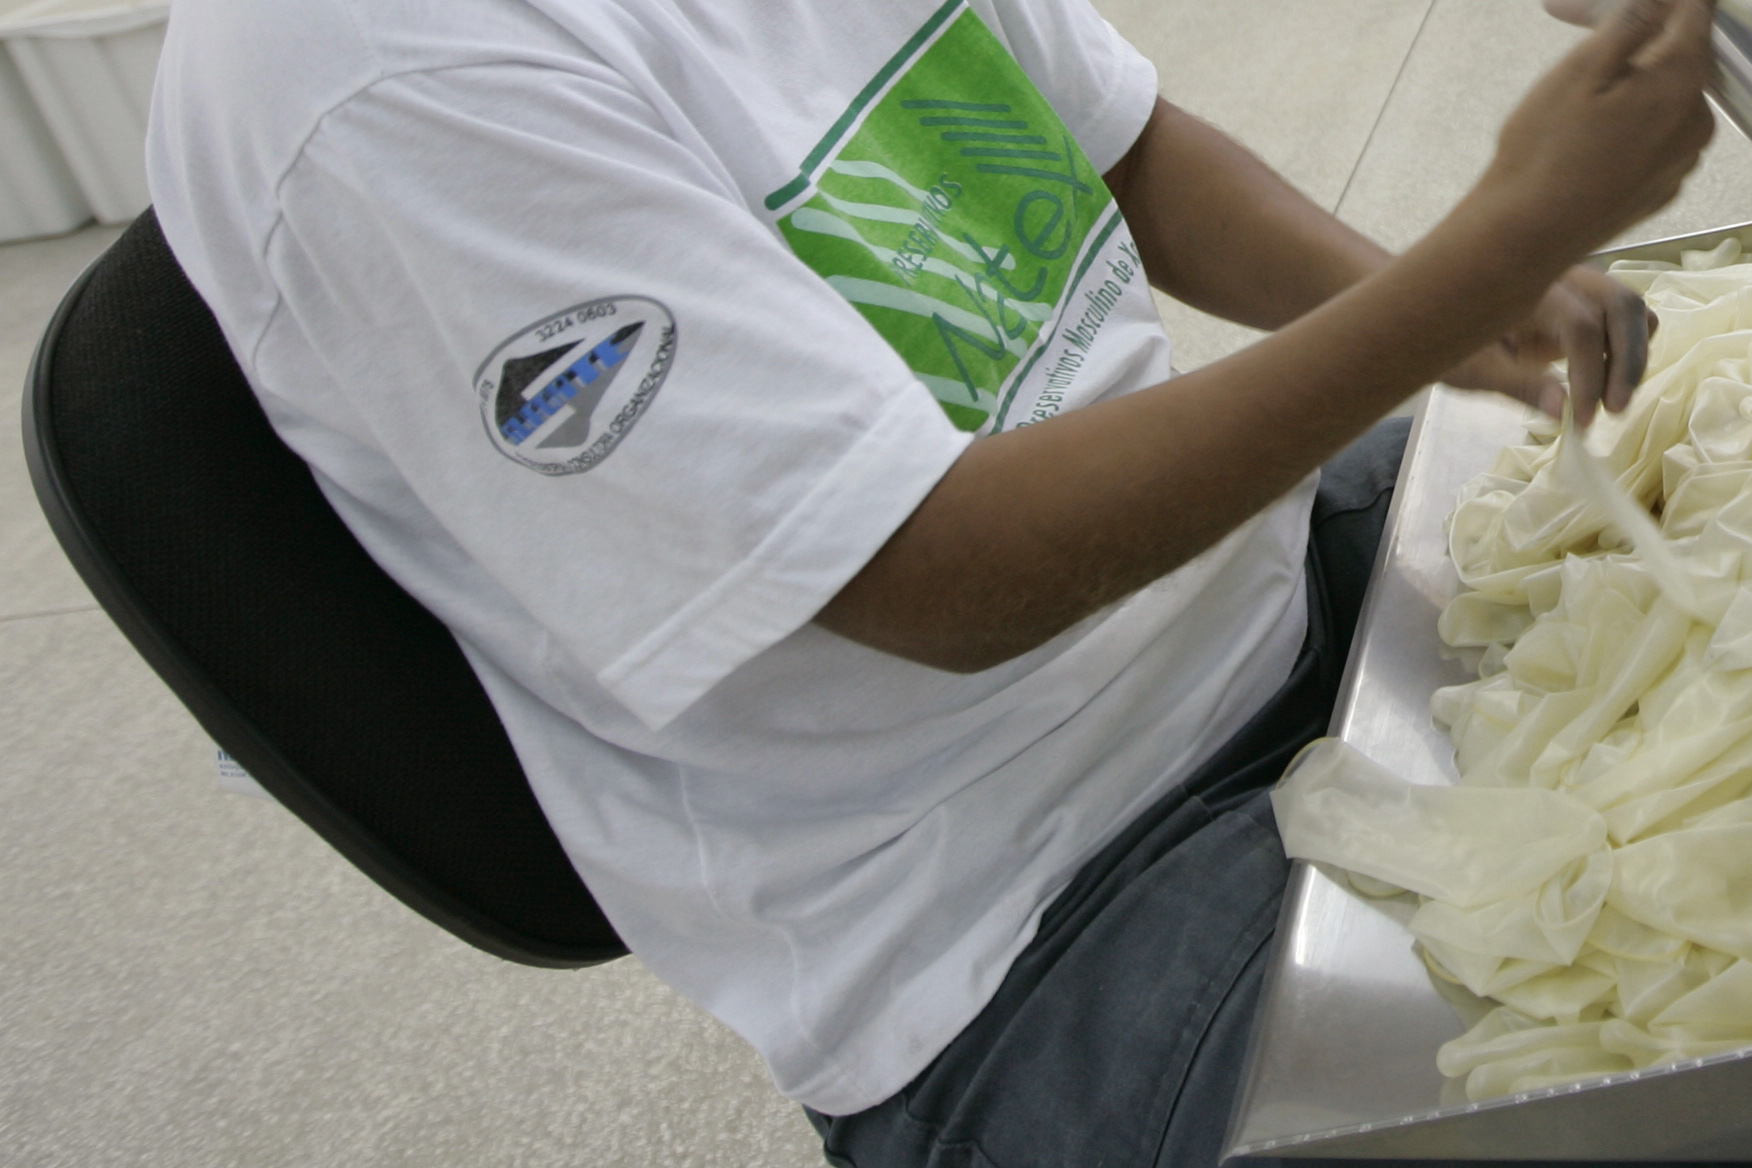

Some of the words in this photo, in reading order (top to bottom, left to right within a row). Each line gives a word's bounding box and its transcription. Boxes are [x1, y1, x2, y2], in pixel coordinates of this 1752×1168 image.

[535, 317, 573, 343] 3224
[1061, 280, 1122, 354] Masculino
[1105, 259, 1134, 284] de
